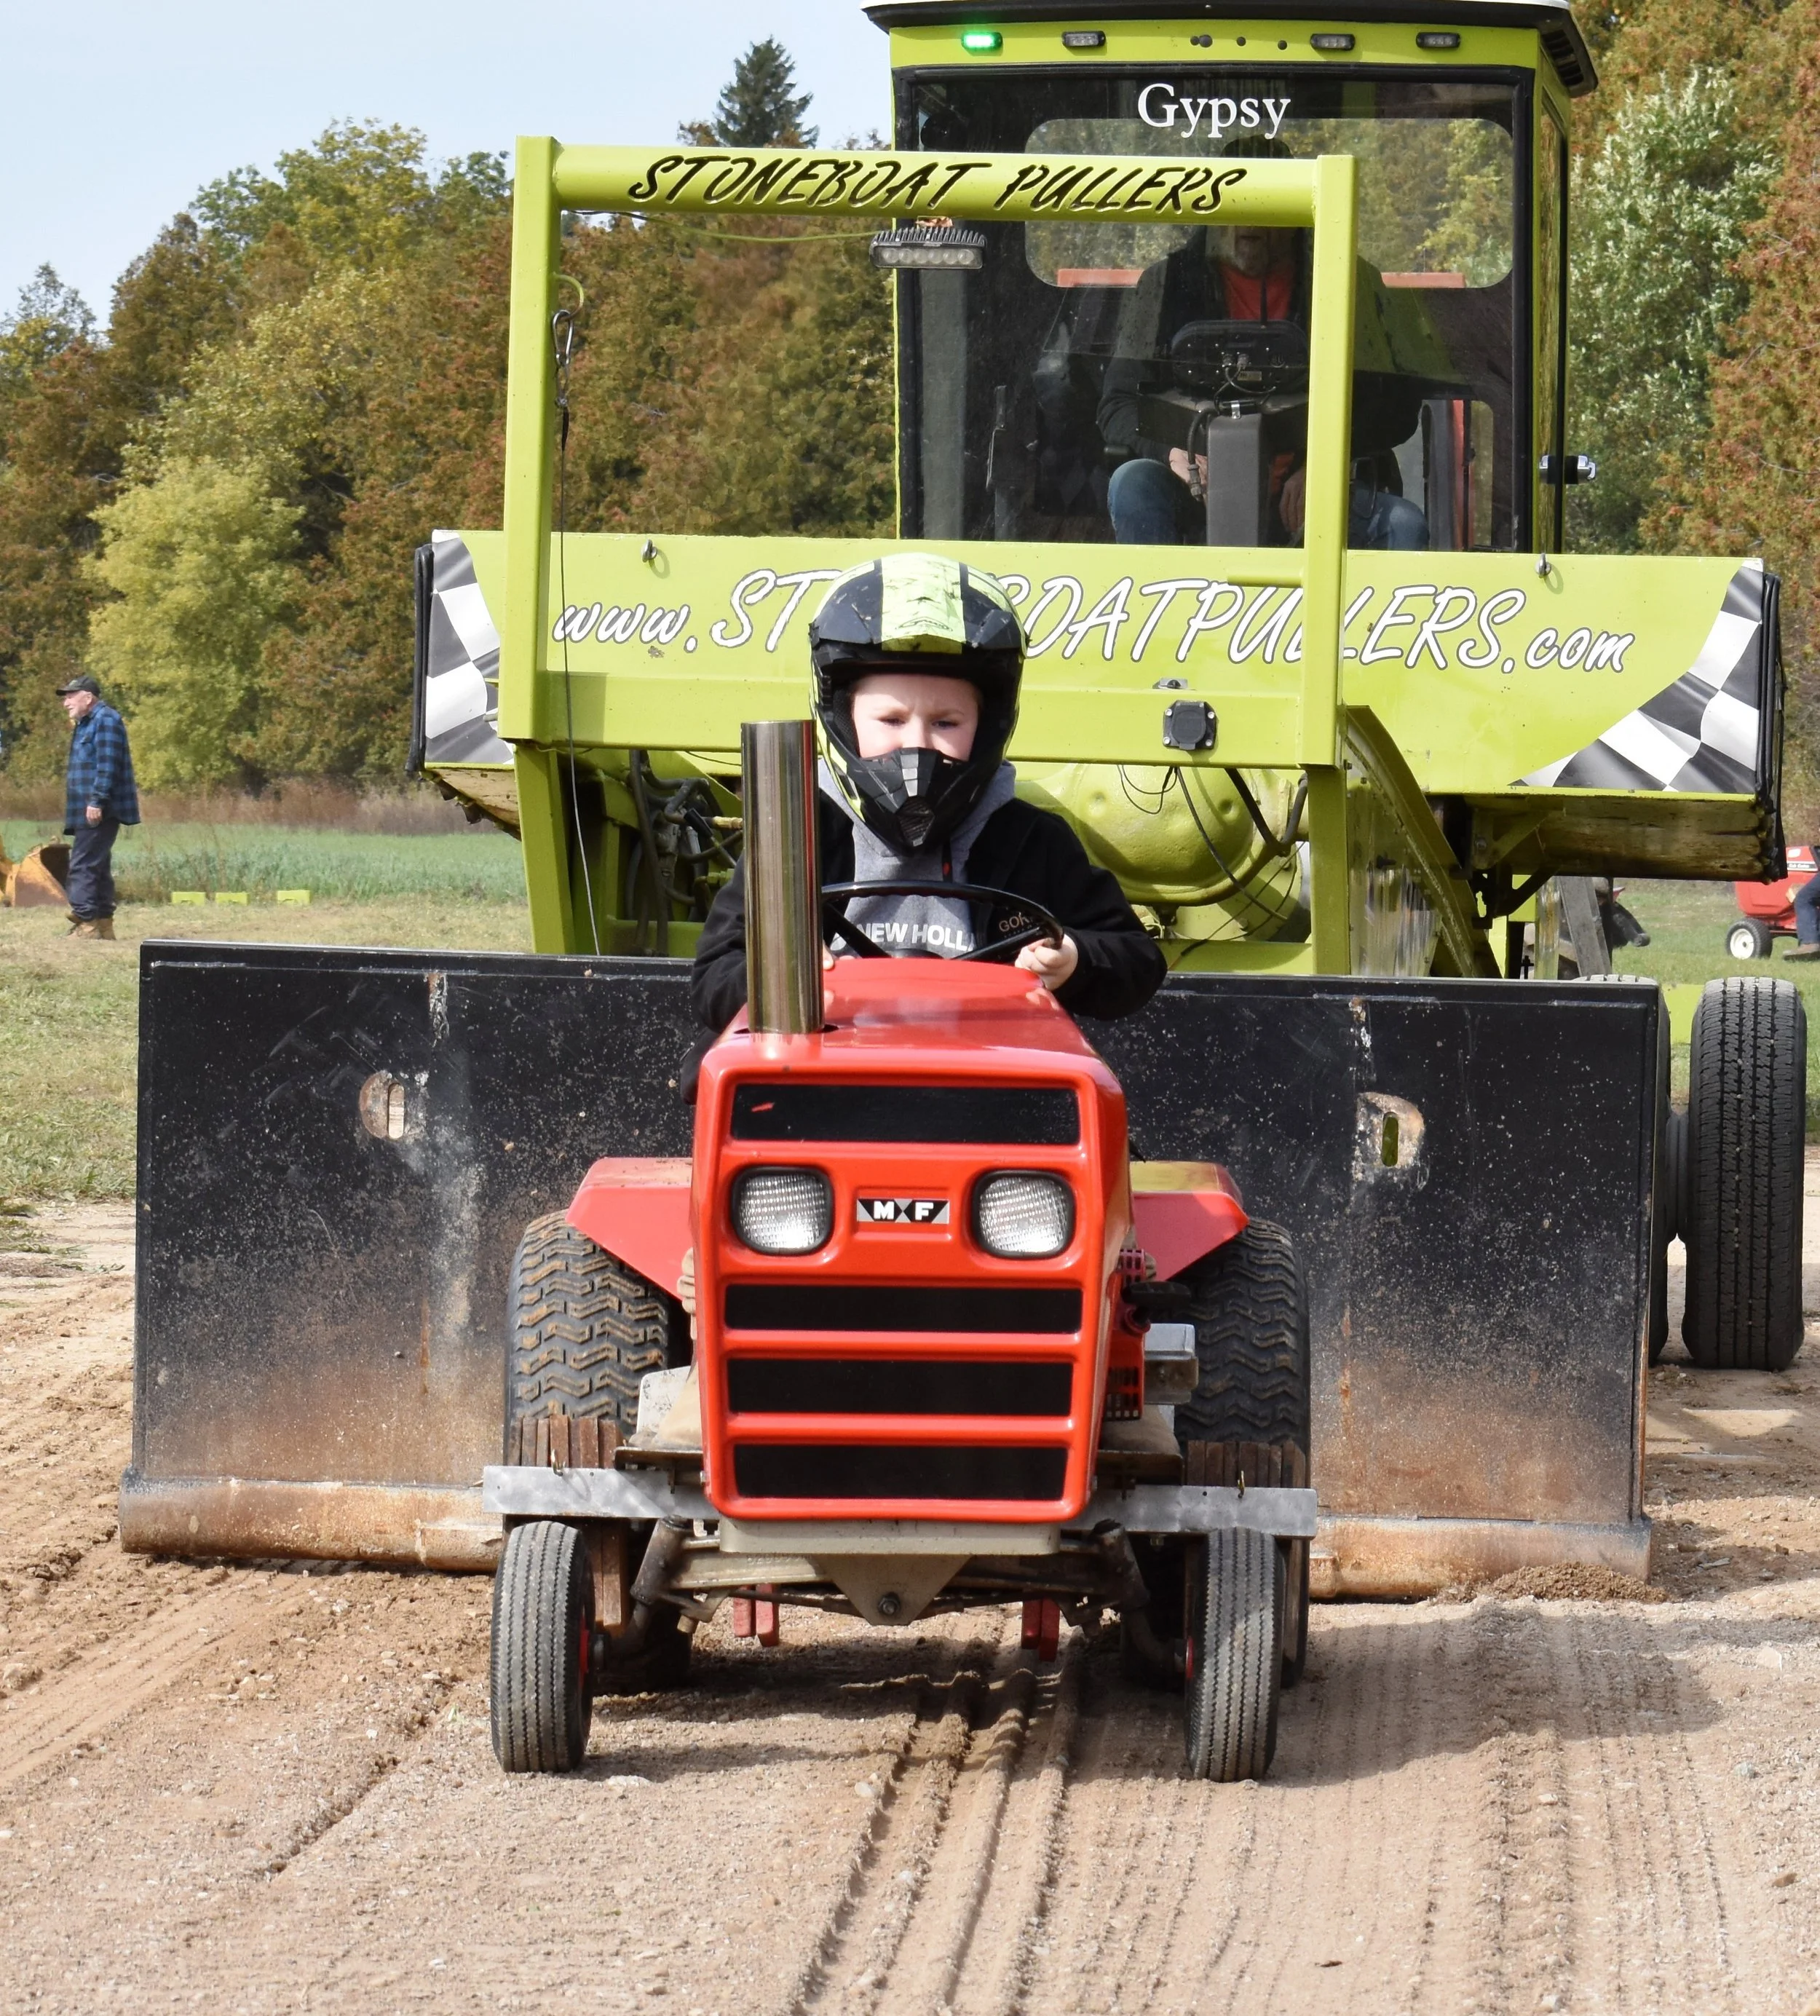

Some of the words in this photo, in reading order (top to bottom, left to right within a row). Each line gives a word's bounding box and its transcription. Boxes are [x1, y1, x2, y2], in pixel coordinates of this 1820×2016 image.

[1137, 83, 1291, 139] Gypsy
[628, 155, 992, 210] STONEBOAT
[993, 165, 1248, 214] PULLERS
[856, 922, 909, 943] NEW
